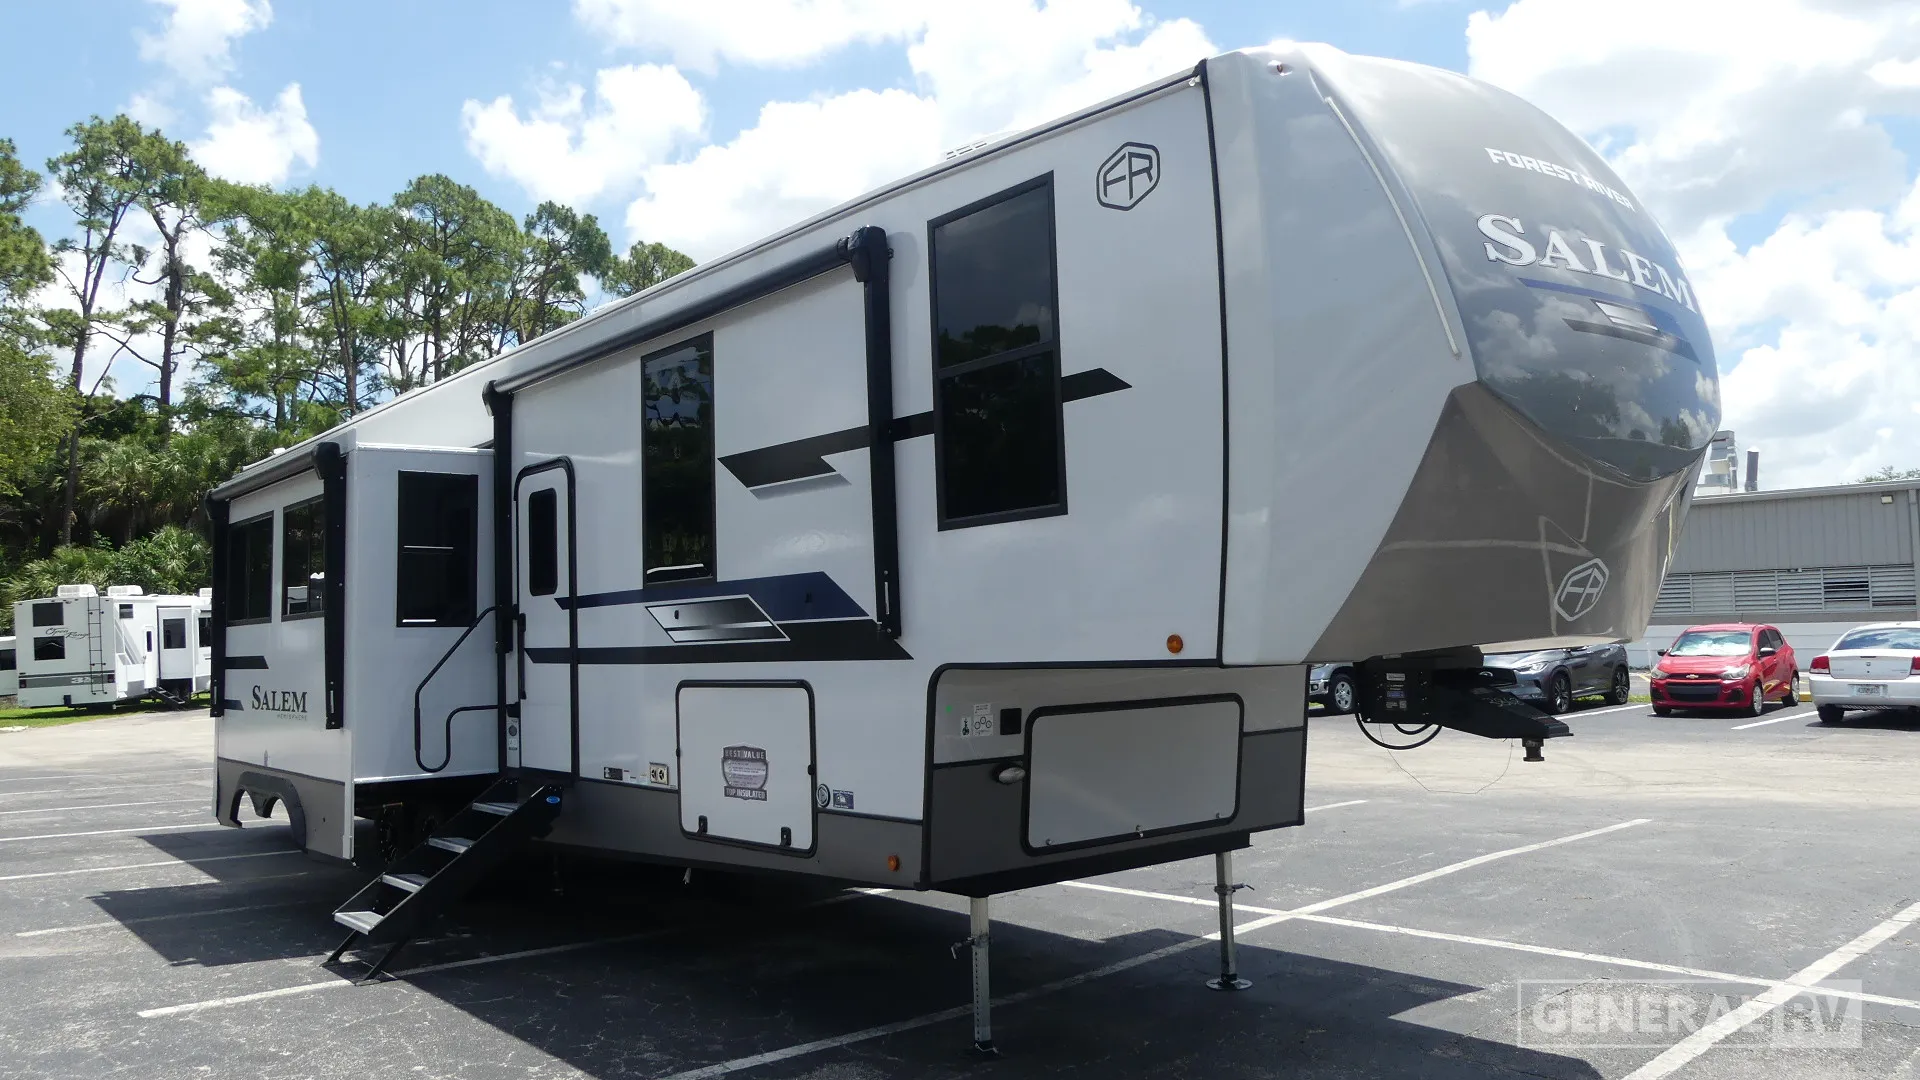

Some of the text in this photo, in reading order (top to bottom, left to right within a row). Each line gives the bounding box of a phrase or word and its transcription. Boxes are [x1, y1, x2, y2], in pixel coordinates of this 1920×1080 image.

[1484, 147, 1636, 213] FOREST RIVER
[1477, 213, 1697, 314] SALEM
[45, 627, 69, 637] Open
[251, 684, 308, 713] SALEM
[725, 749, 765, 760] BEST VALUE
[737, 788, 766, 799] INSULATED
